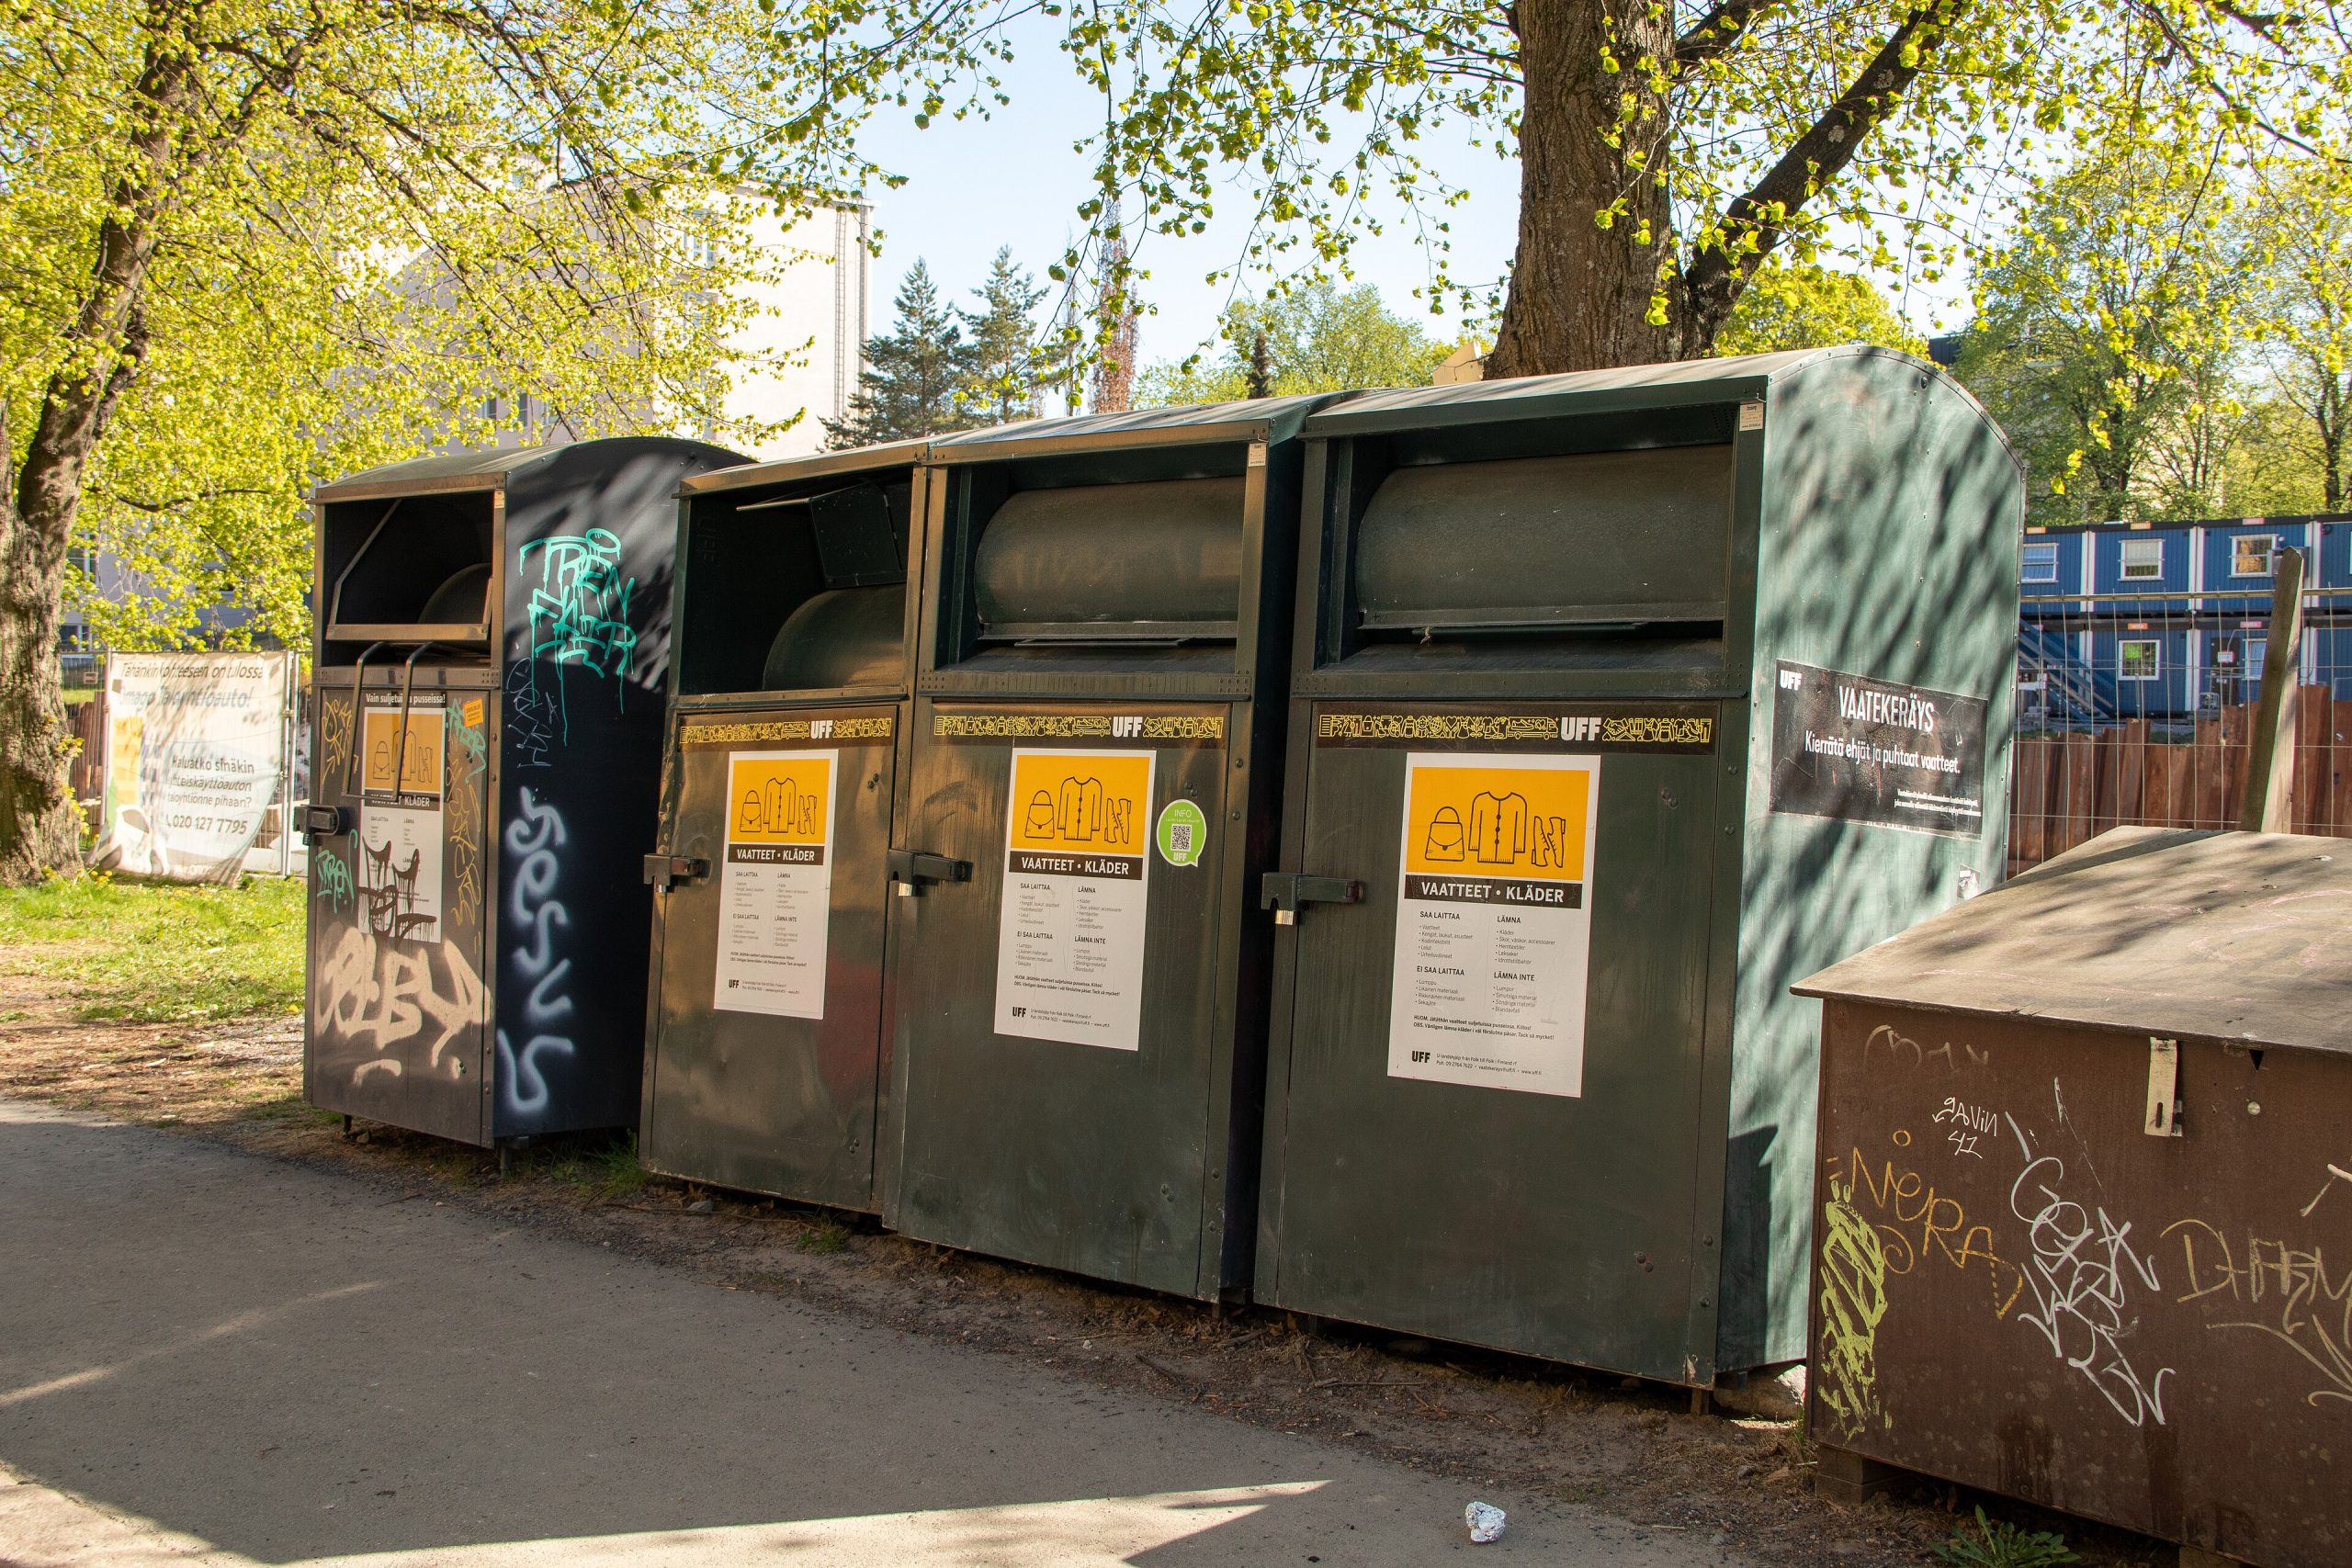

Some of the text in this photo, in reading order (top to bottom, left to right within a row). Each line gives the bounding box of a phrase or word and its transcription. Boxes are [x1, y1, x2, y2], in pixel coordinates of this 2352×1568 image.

[211, 665, 226, 678] on
[1780, 670, 1803, 691] UFF
[366, 693, 379, 703] Vain
[413, 694, 446, 705] pusseissa!
[1838, 685, 1935, 733] VAATEKERÄYS
[810, 720, 833, 739] UFF
[1113, 716, 1143, 738] UFF
[1560, 716, 1602, 742] UFF
[1804, 729, 1961, 773] Kierrätä ehjät ja puhtaat vaatteet.
[215, 757, 254, 774] sinäkin
[214, 795, 252, 808] pihaan?
[404, 795, 430, 807] KLÄDER
[1174, 809, 1192, 818] INFO
[173, 815, 248, 835] 020 127 7795
[737, 848, 814, 861] VAATTEET KLÄDER
[1173, 852, 1187, 861] UFF
[1022, 856, 1129, 875] VAATTEET KLÄDER
[1421, 882, 1564, 903] VAATTEET KLÄDER
[1419, 910, 1432, 919] SAA
[1497, 914, 1521, 924] LÄMNA
[1424, 965, 1437, 974] SAA
[1438, 967, 1464, 976] LAITTAA
[1493, 971, 1535, 982] LÄMNA INTE
[729, 979, 740, 988] UFF
[1012, 1007, 1026, 1018] UFF
[1411, 1050, 1430, 1063] UFF
